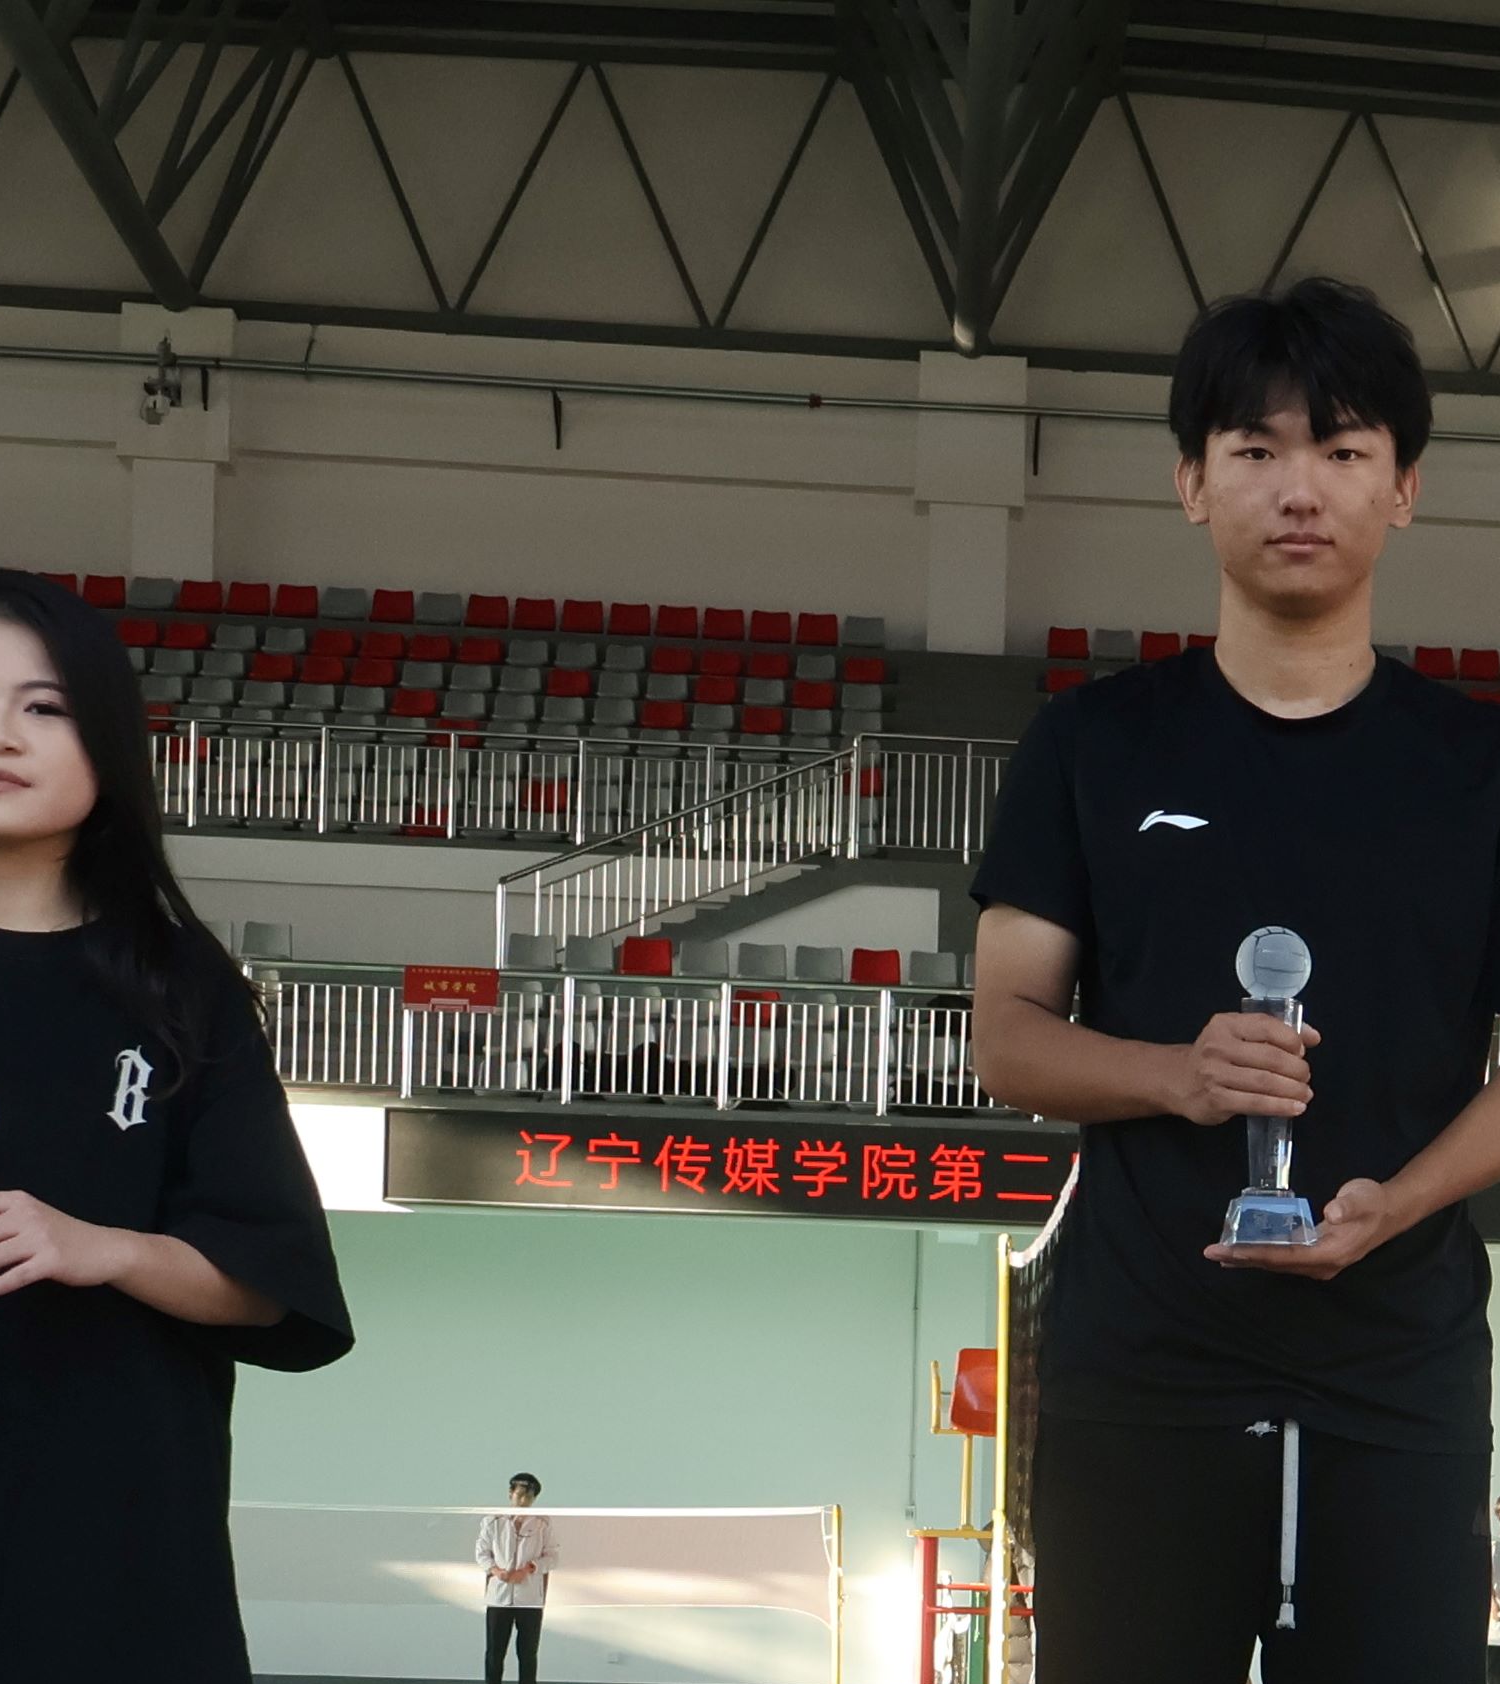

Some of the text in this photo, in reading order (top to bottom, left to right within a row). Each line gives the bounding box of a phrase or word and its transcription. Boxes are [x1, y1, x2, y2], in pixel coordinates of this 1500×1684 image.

[514, 1129, 1080, 1204] 辽宁传媒学院第二
